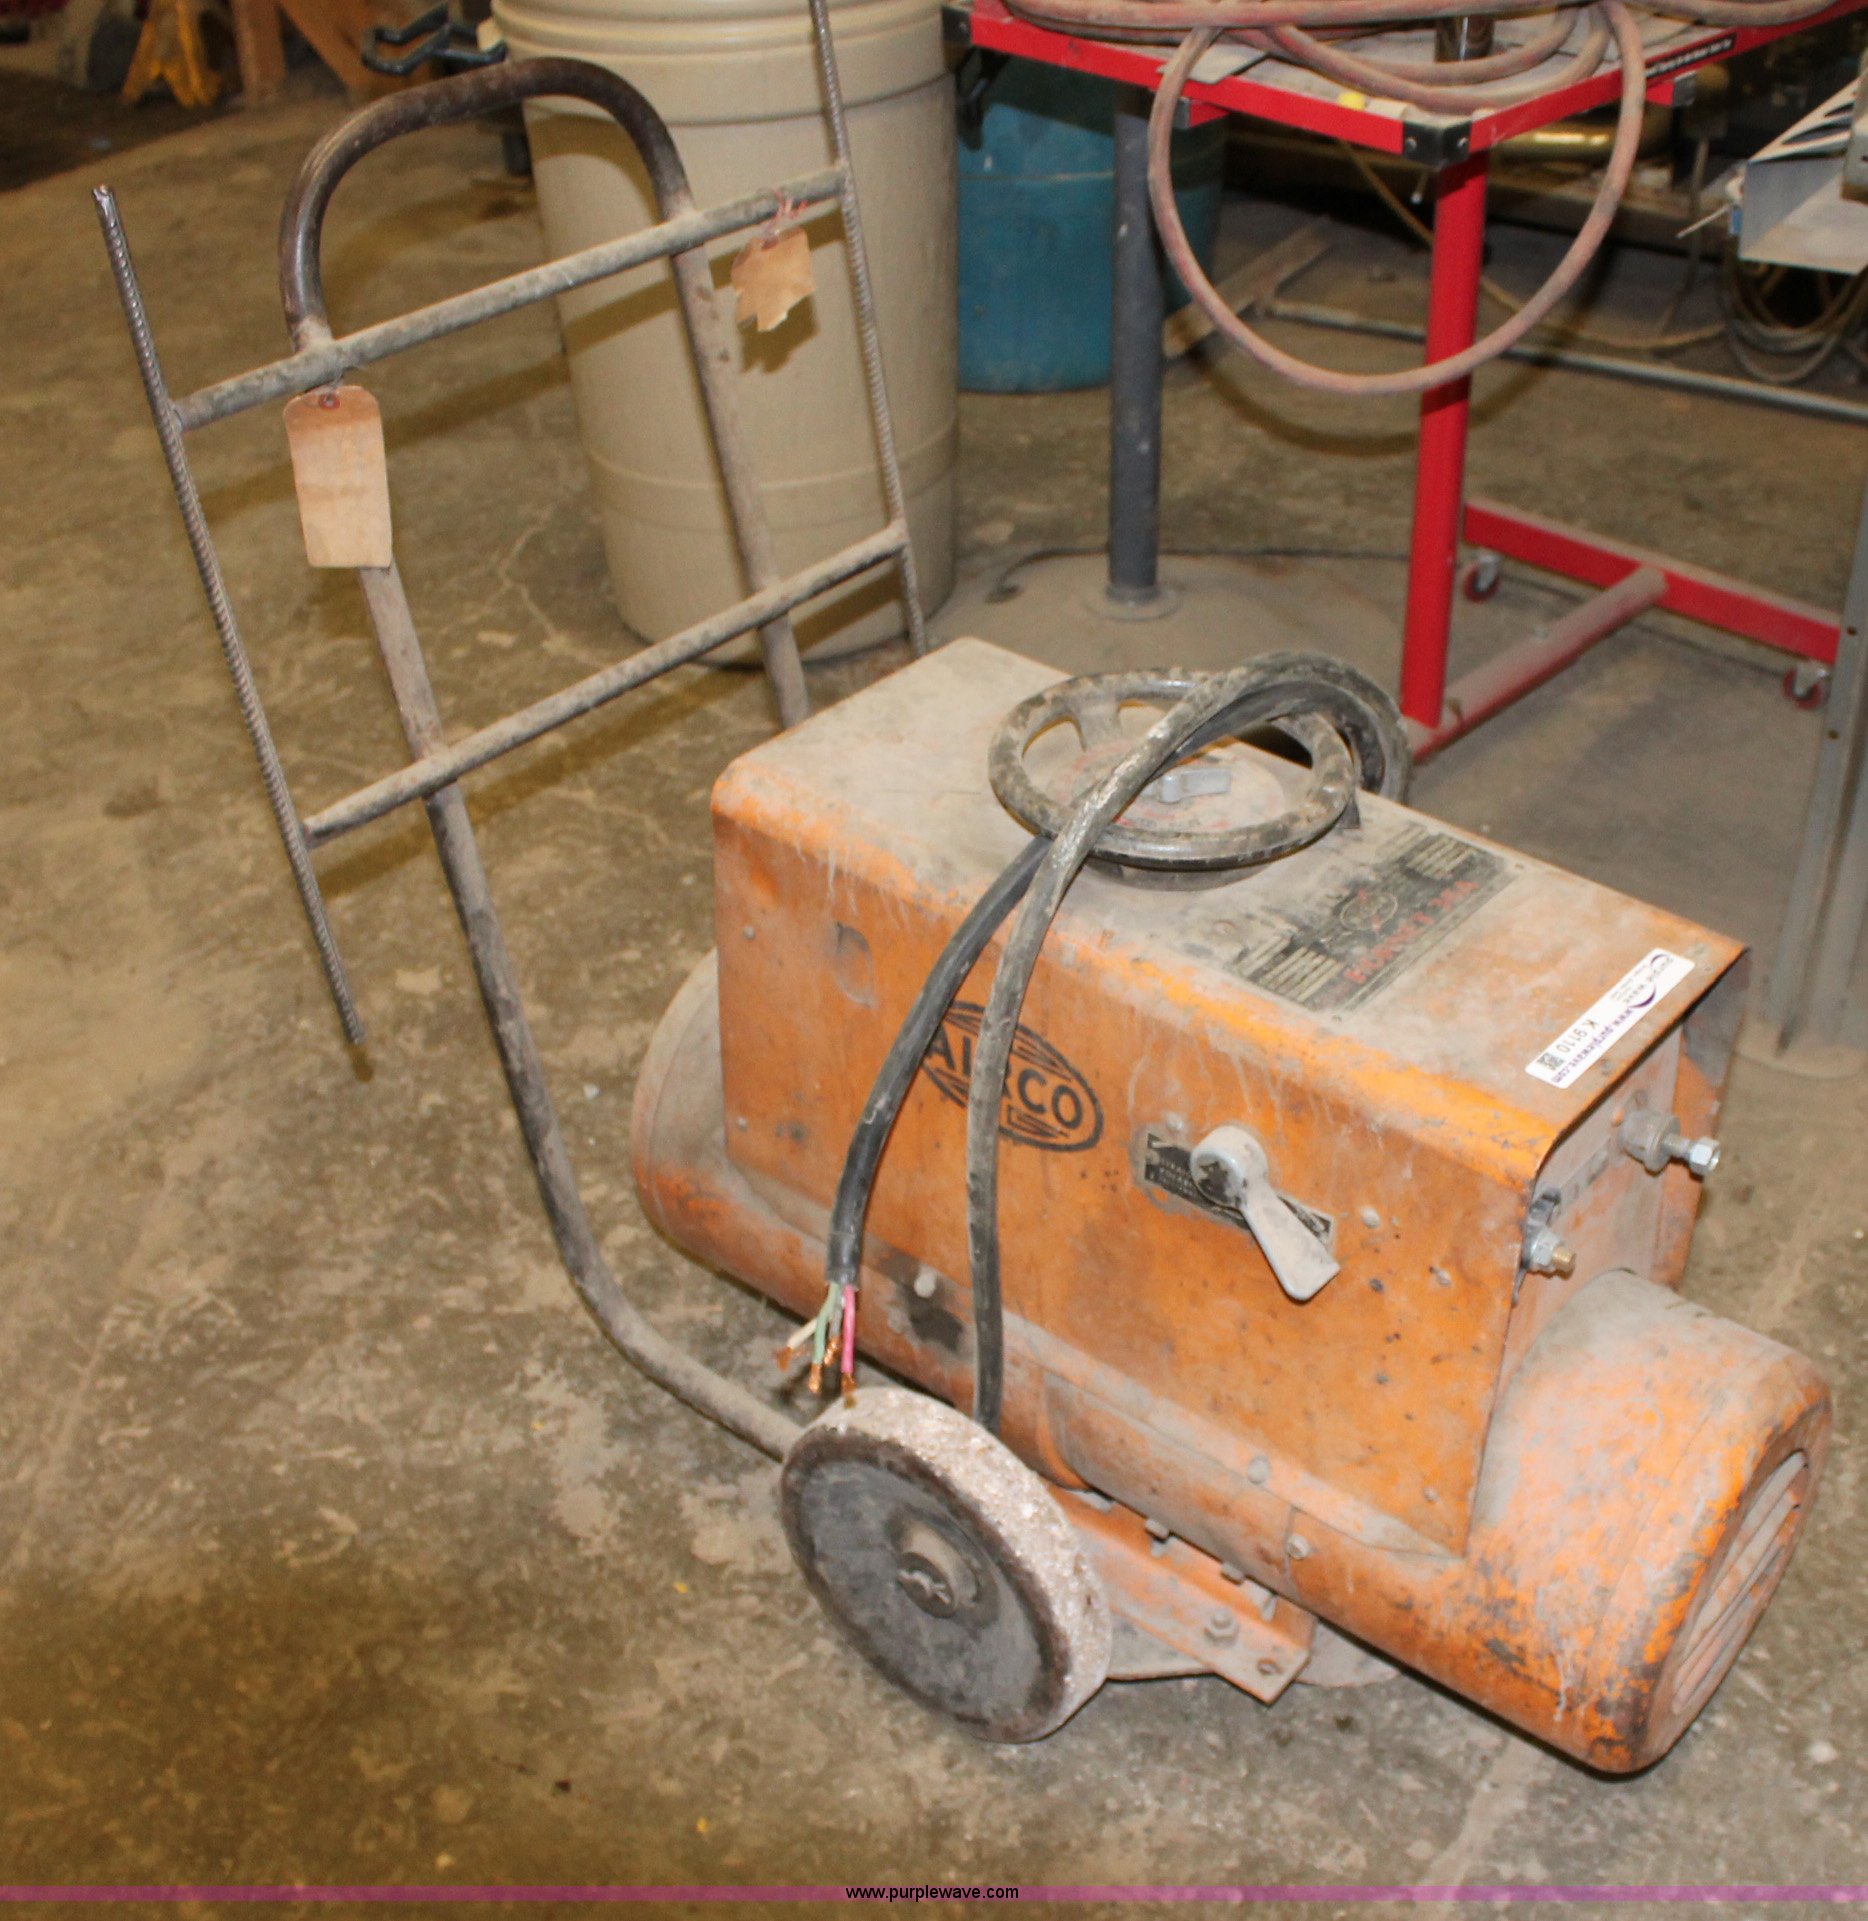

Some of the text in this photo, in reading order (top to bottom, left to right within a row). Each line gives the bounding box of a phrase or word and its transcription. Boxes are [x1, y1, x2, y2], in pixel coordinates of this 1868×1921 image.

[1552, 1008, 1633, 1083] www.purplewave.com
[1556, 1019, 1599, 1054] K 9110
[925, 1023, 1083, 1129] AICO
